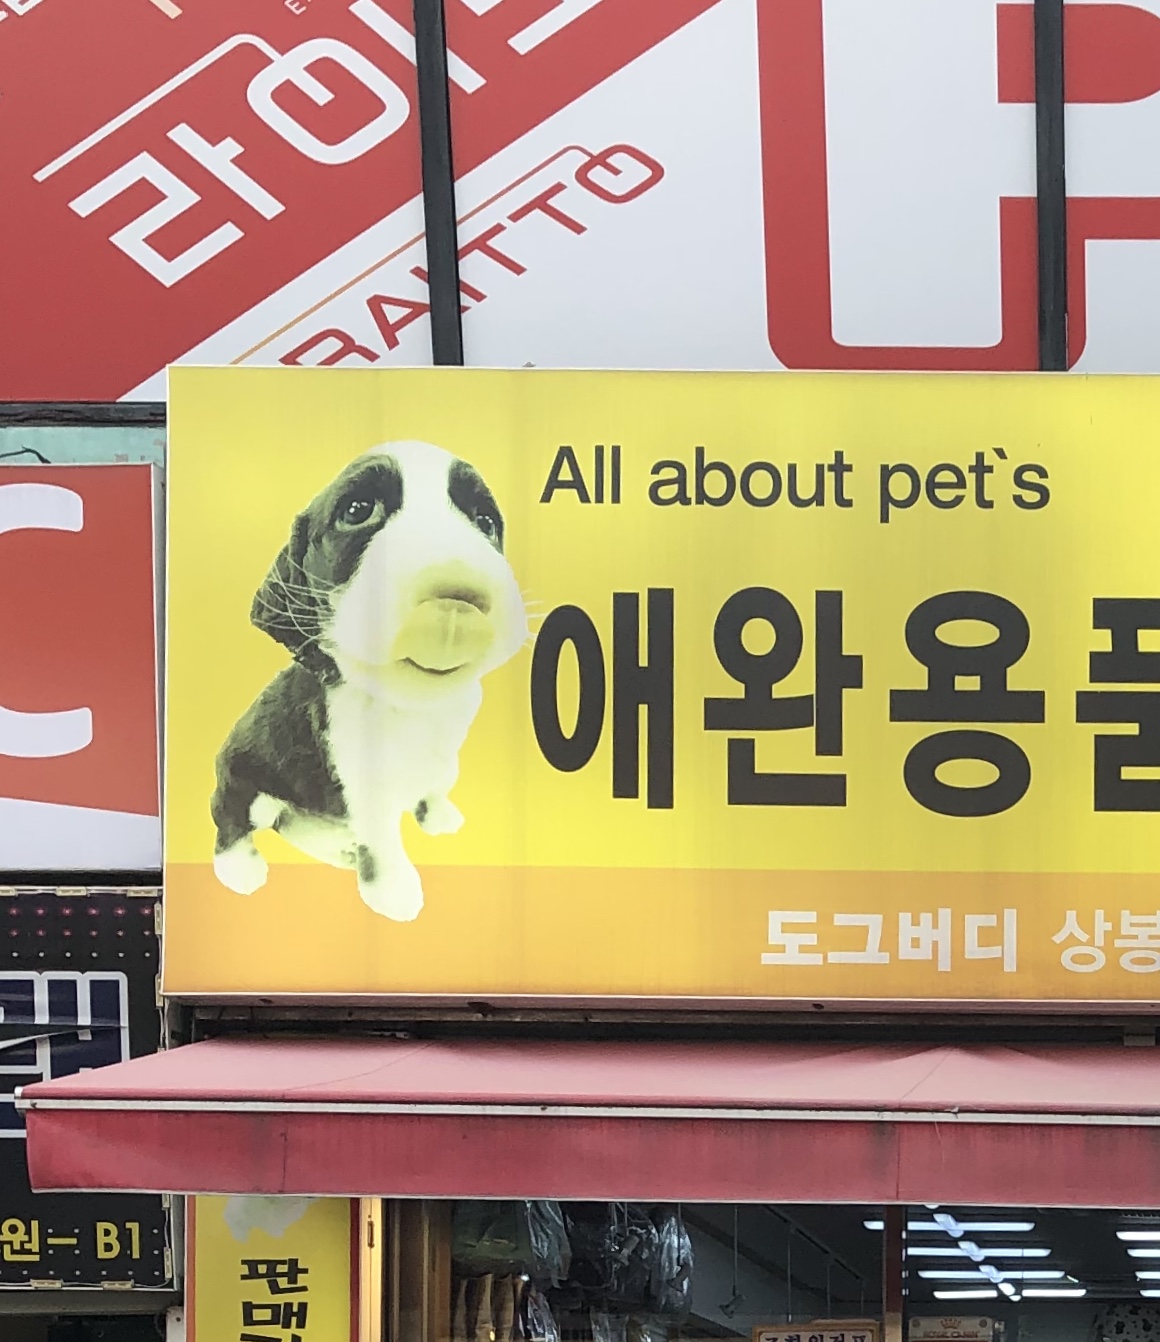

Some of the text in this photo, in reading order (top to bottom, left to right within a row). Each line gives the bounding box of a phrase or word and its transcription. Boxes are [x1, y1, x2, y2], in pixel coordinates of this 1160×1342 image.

[540, 445, 621, 504] All
[648, 446, 853, 508] about
[760, 908, 1019, 973] 도그버디
